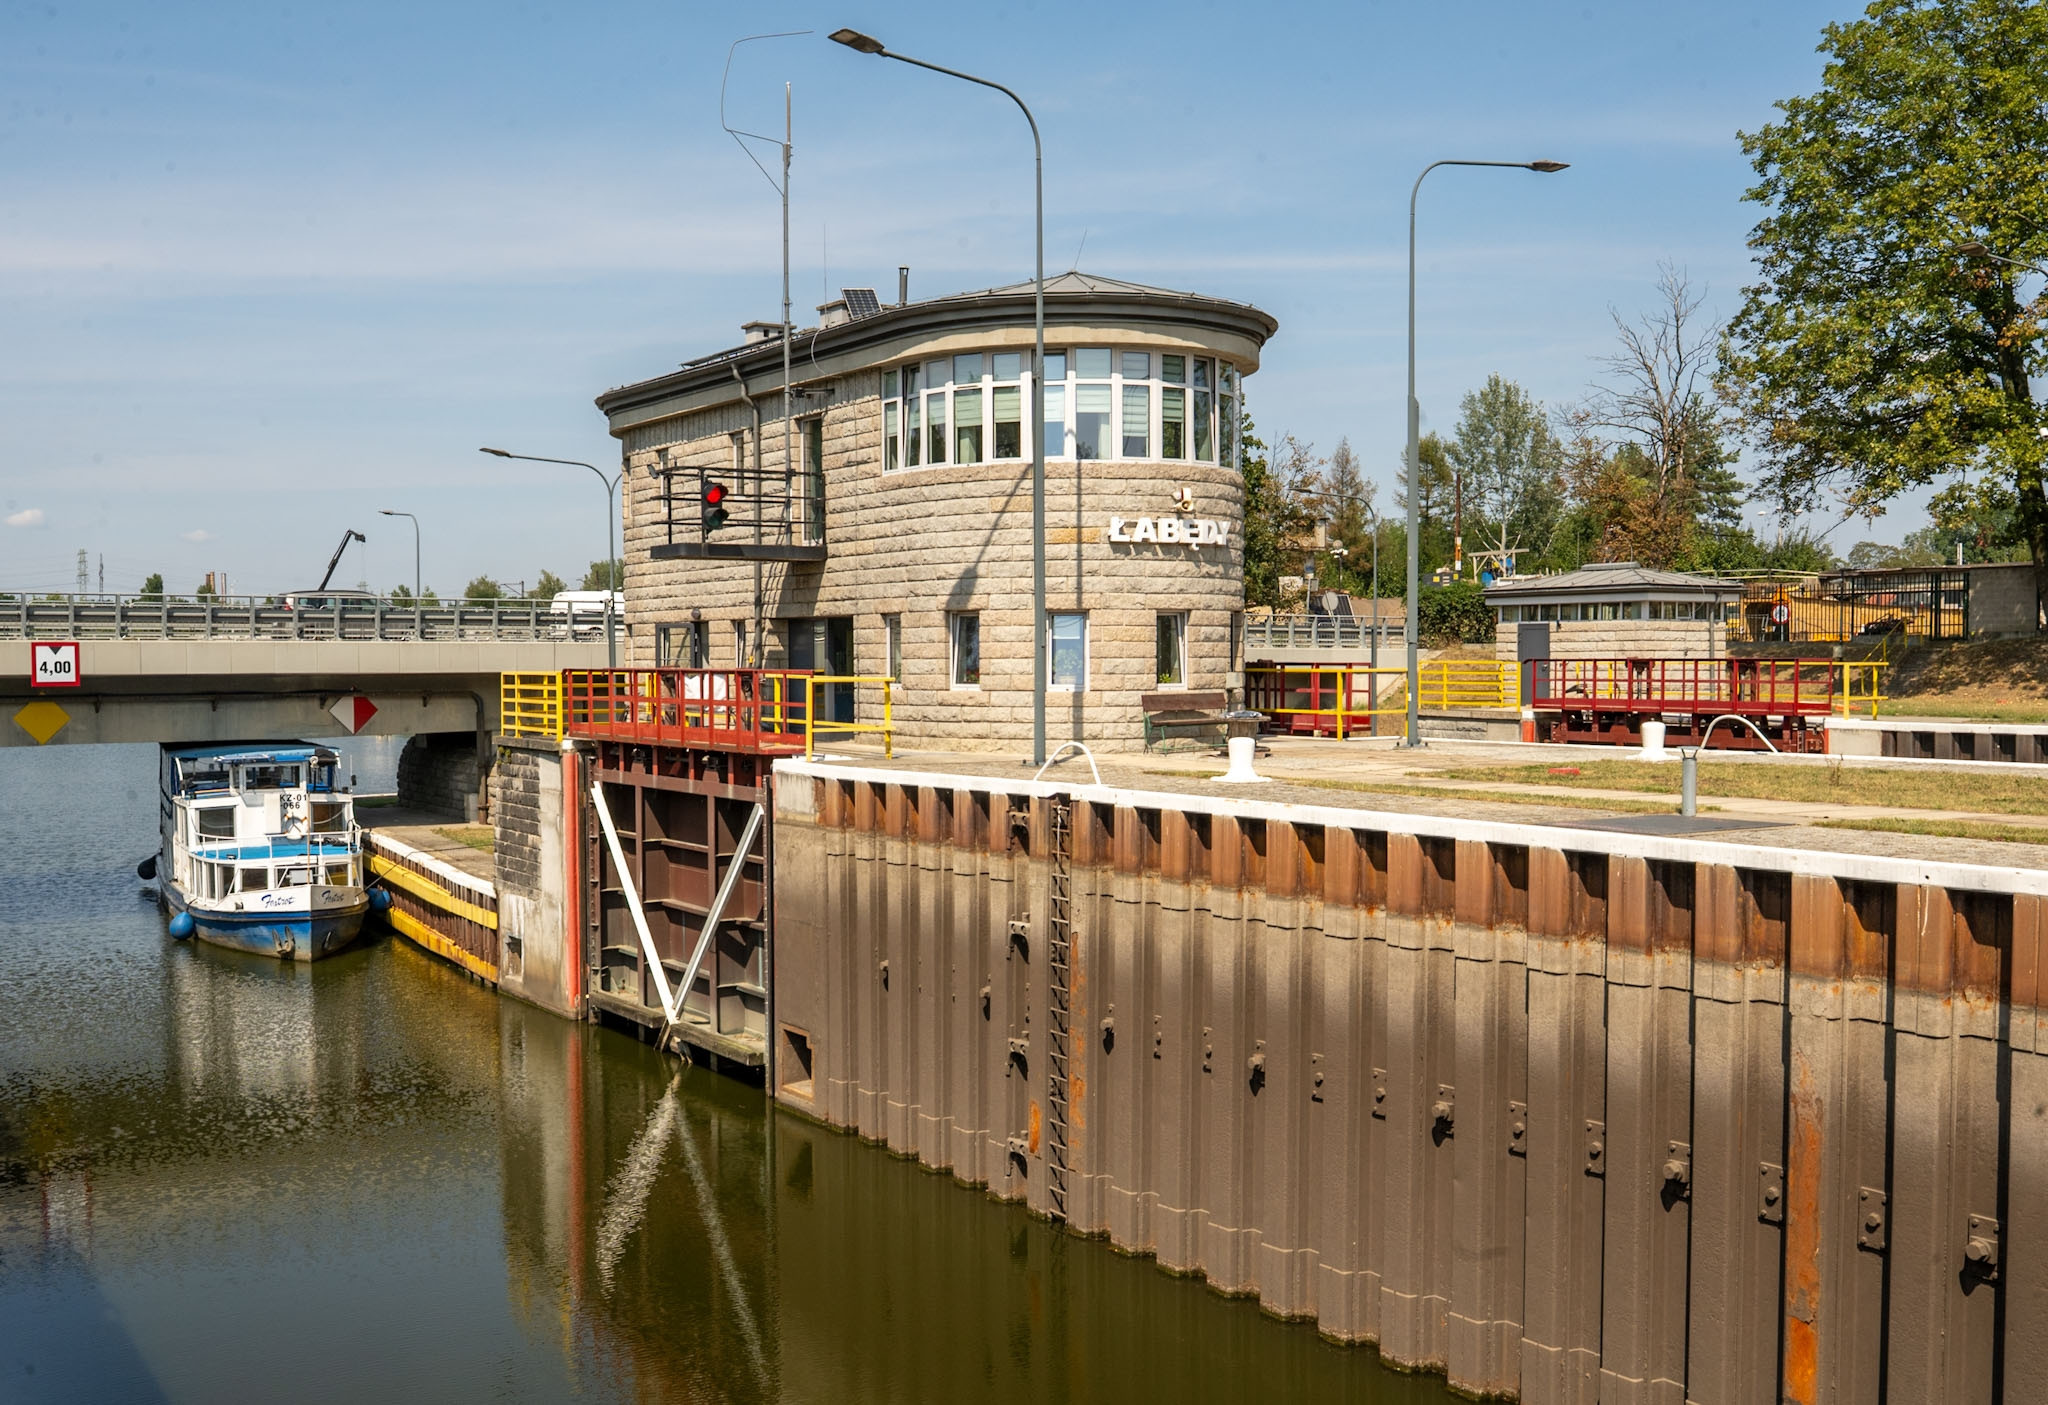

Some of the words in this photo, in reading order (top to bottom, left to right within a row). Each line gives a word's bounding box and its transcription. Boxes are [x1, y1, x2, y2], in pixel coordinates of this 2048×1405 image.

[1108, 516, 1231, 551] ŁABĘDY
[40, 661, 71, 676] 4,00
[280, 794, 307, 802] KZ-01
